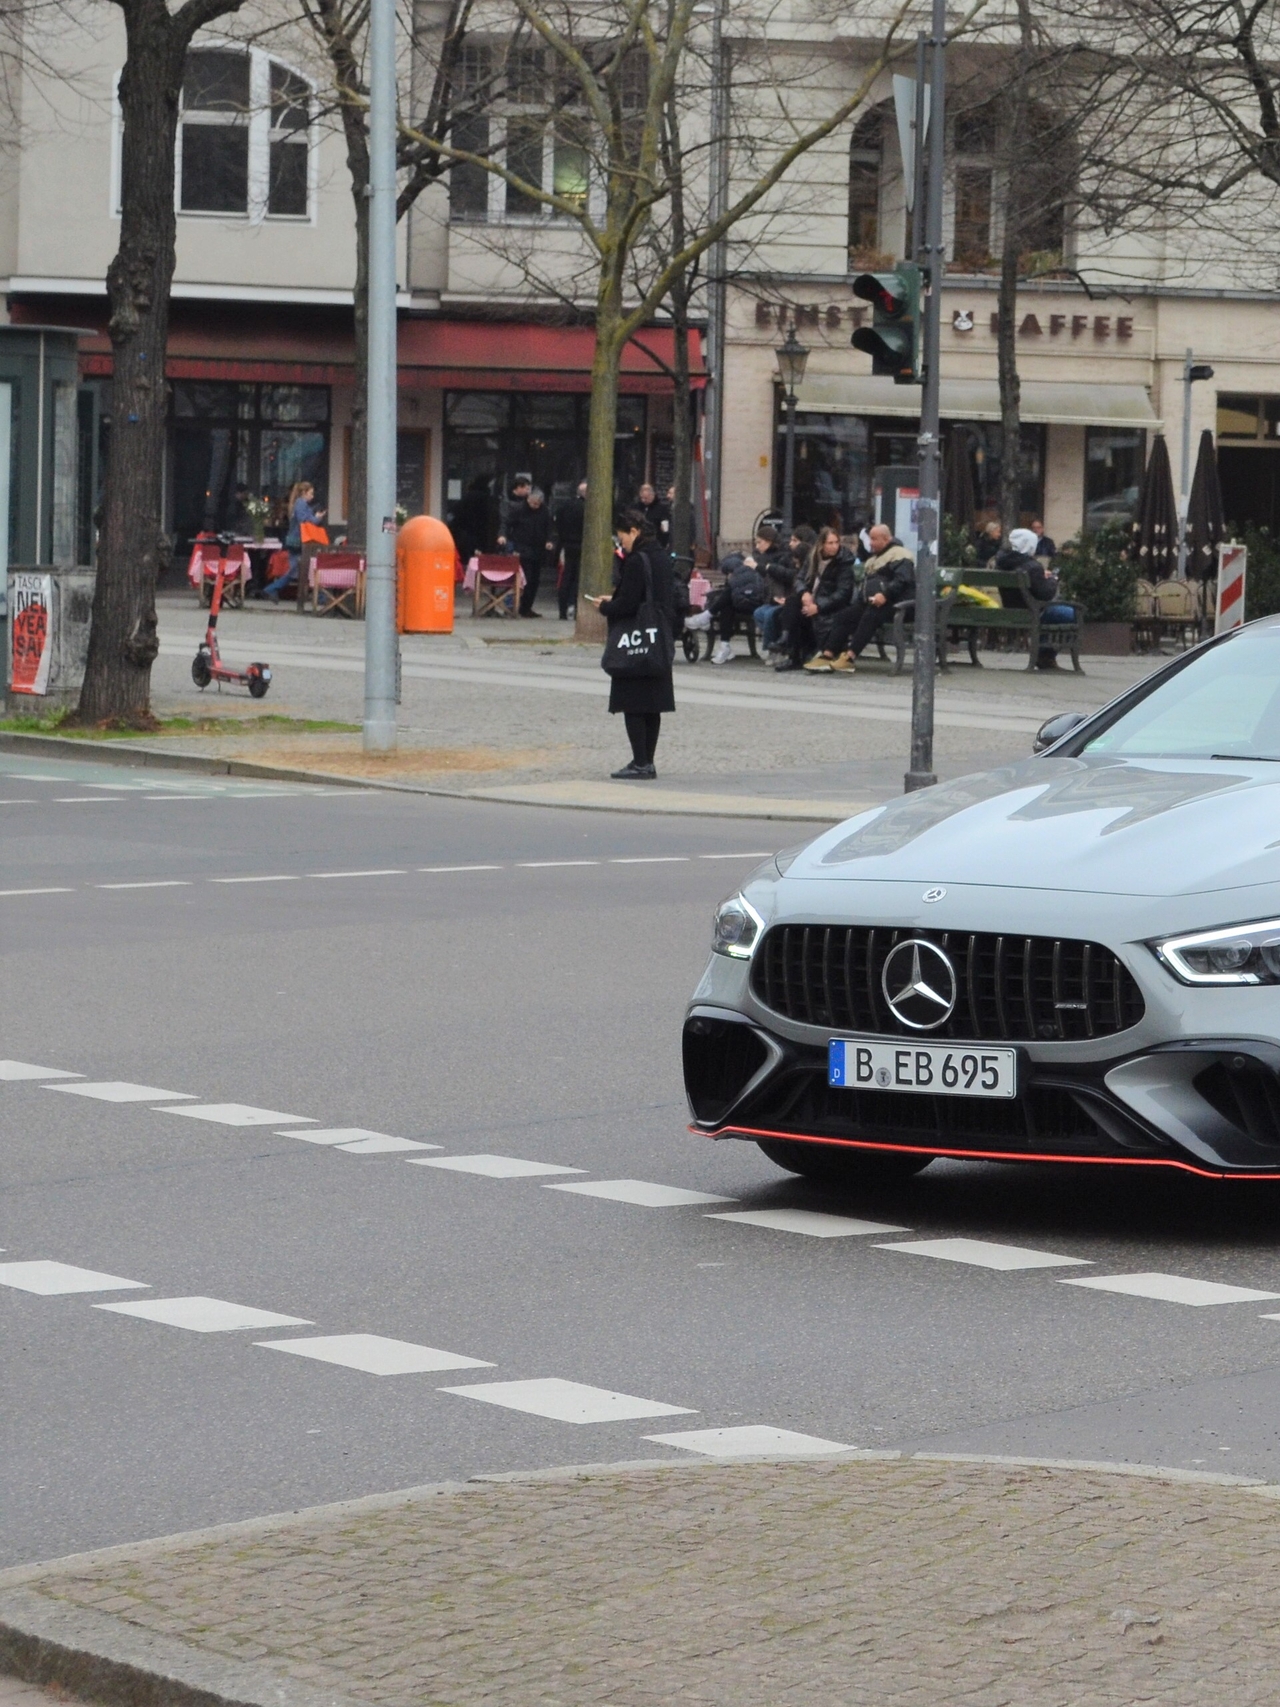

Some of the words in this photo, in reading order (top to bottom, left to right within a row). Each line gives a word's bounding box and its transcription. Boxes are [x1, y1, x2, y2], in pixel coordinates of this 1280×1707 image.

[18, 612, 47, 637] YEA
[833, 1069, 841, 1079] D
[856, 1048, 874, 1083] B
[895, 1051, 934, 1087] EB
[941, 1054, 999, 1091] 695
